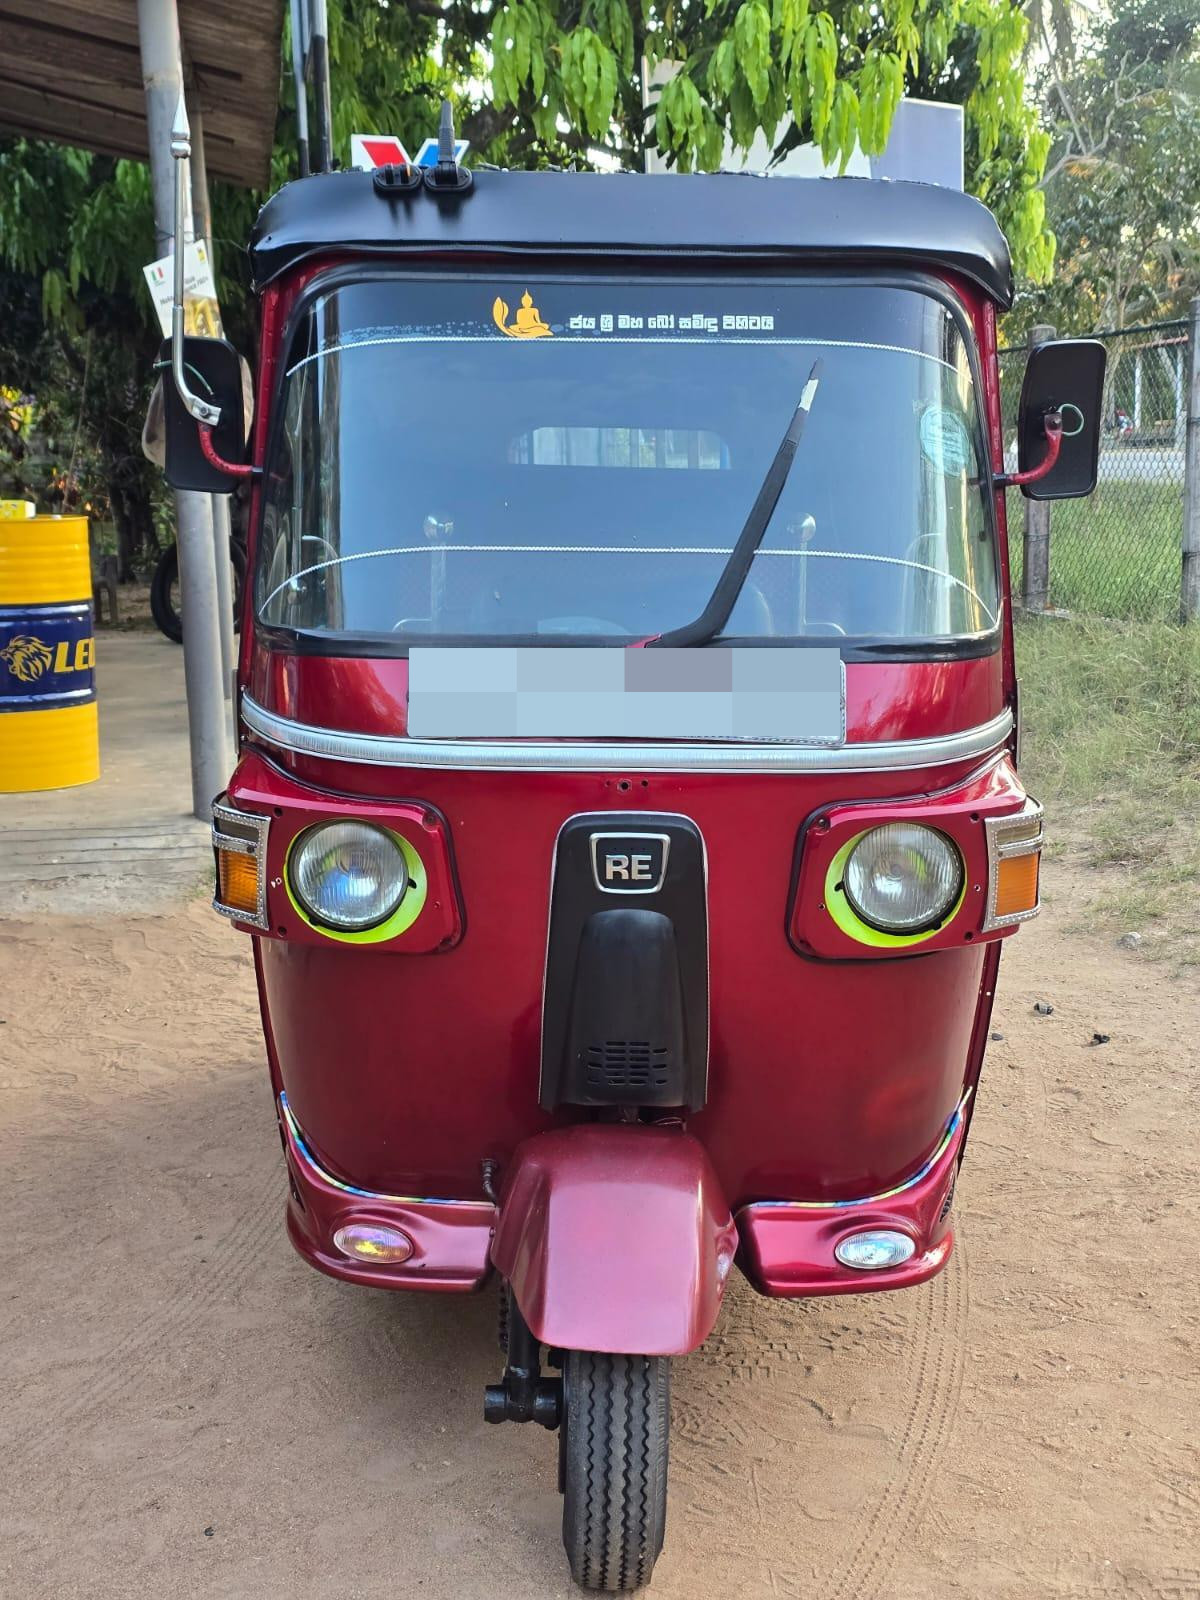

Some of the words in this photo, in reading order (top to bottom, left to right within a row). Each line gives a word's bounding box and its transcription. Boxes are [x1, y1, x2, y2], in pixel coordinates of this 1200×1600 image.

[569, 314, 596, 329] ජය
[618, 314, 644, 329] මහ
[722, 315, 774, 330] පිහිටයි
[605, 854, 652, 880] RE
